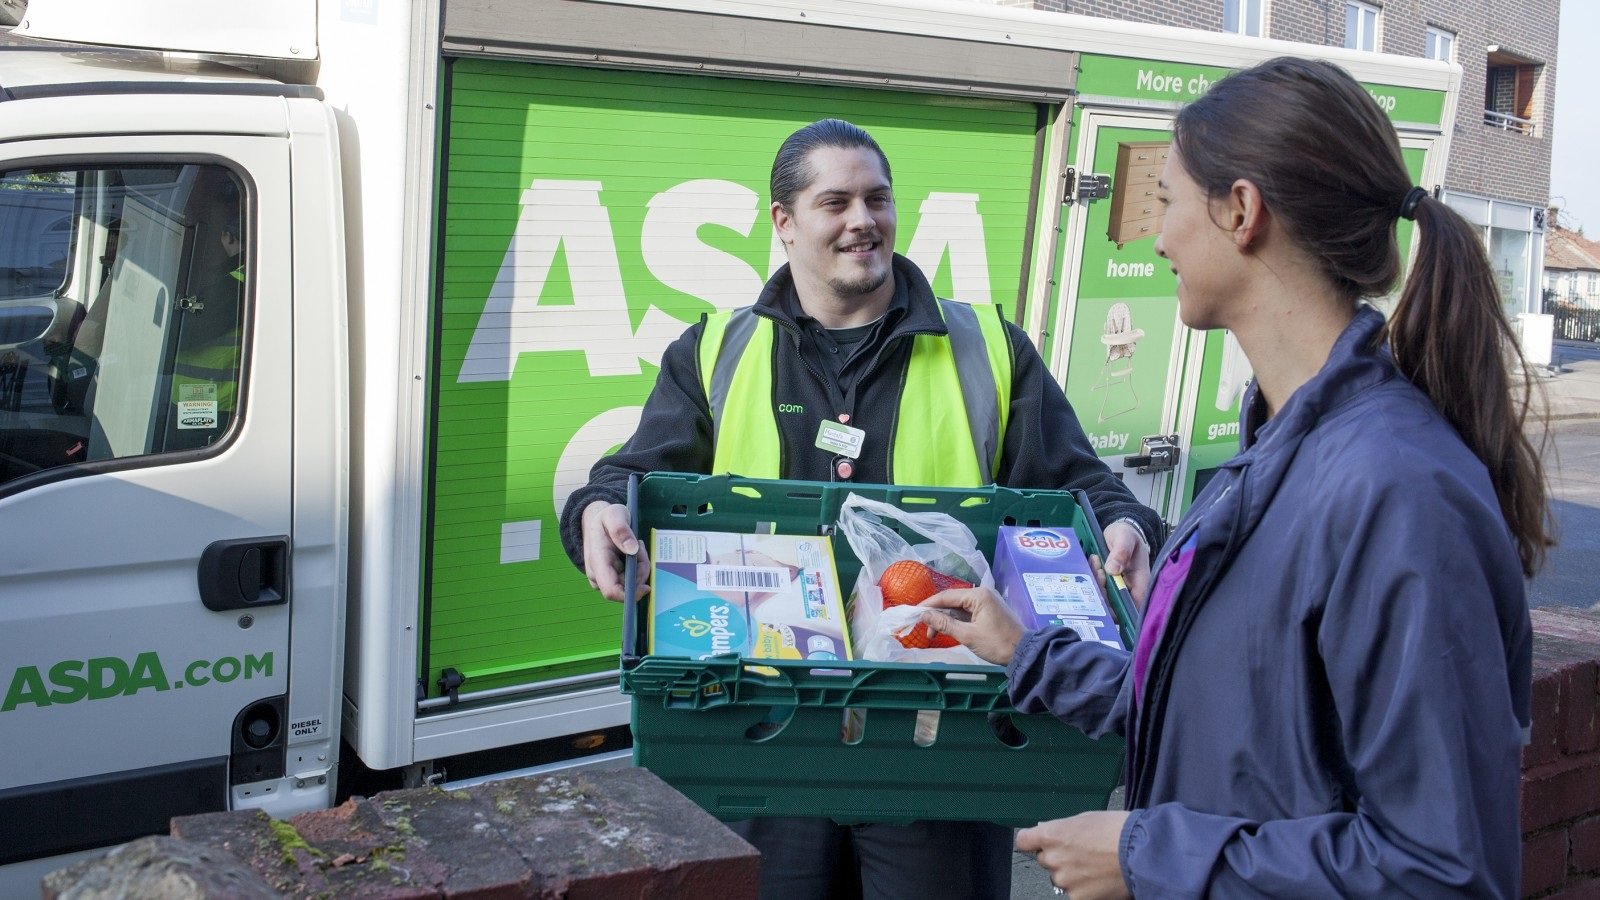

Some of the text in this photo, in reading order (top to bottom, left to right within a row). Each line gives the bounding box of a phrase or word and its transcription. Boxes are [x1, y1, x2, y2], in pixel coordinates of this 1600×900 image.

[1137, 70, 1182, 93] More
[1107, 259, 1154, 277] home
[457, 179, 992, 384] ASA
[778, 403, 804, 414] com
[1089, 430, 1130, 450] baby
[1018, 536, 1069, 549] Bold
[1, 651, 274, 712] ASDA.COM
[291, 719, 322, 730] DIESEL
[294, 726, 319, 737] ONLY
